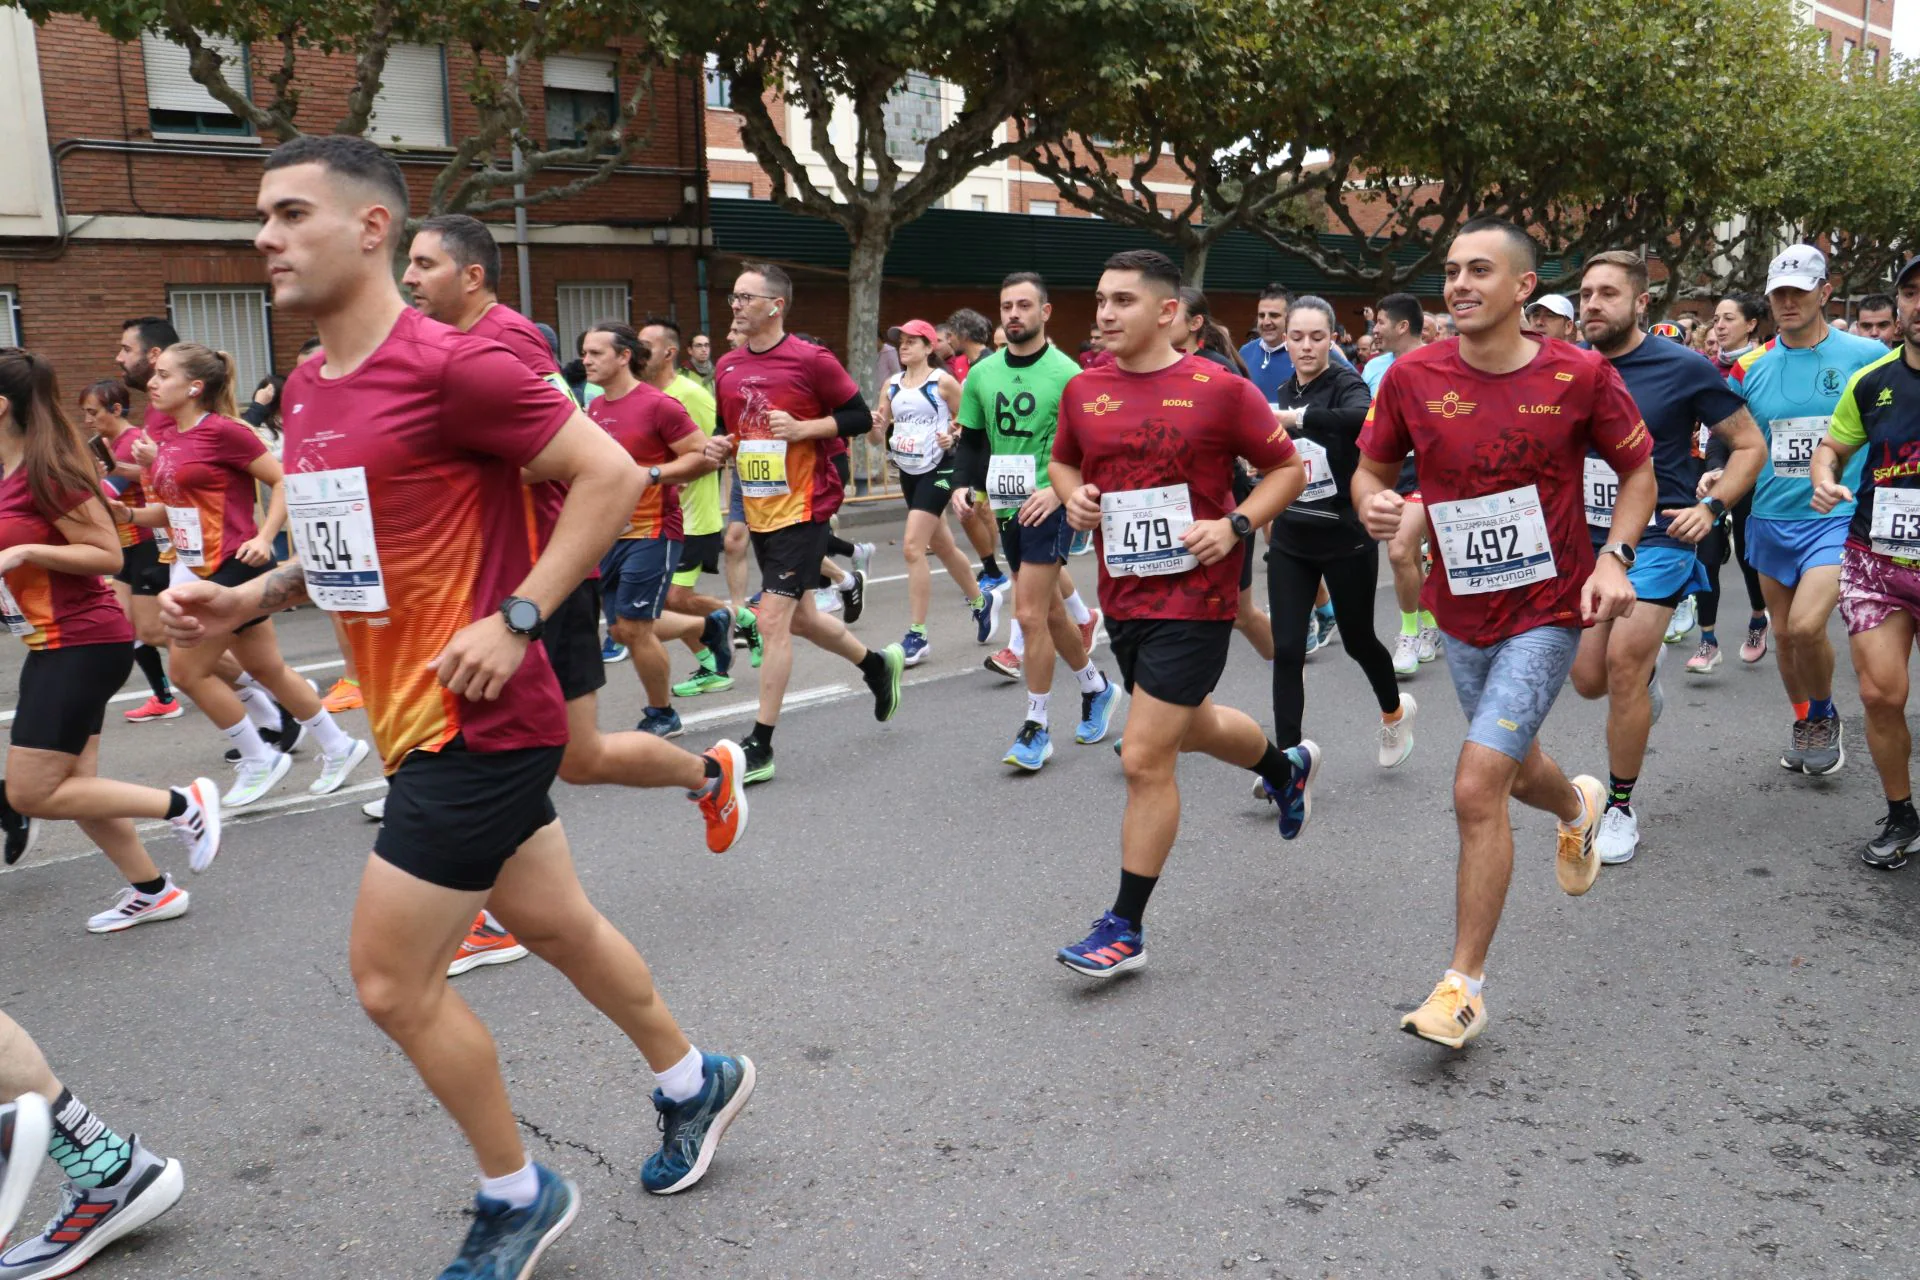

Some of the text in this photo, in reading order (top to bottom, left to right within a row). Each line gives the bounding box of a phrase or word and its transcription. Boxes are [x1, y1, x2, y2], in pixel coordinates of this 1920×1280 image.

[1162, 399, 1194, 408] BODAS
[1518, 403, 1561, 415] G. LÓPEZ
[747, 459, 770, 481] 108
[997, 474, 1026, 495] 608
[1132, 510, 1153, 519] BODAS
[1123, 517, 1172, 552] 479
[304, 520, 352, 571] 434
[1465, 524, 1524, 565] 492
[1138, 558, 1183, 571] HYUNDAI
[1485, 567, 1537, 585] HYUNDAI
